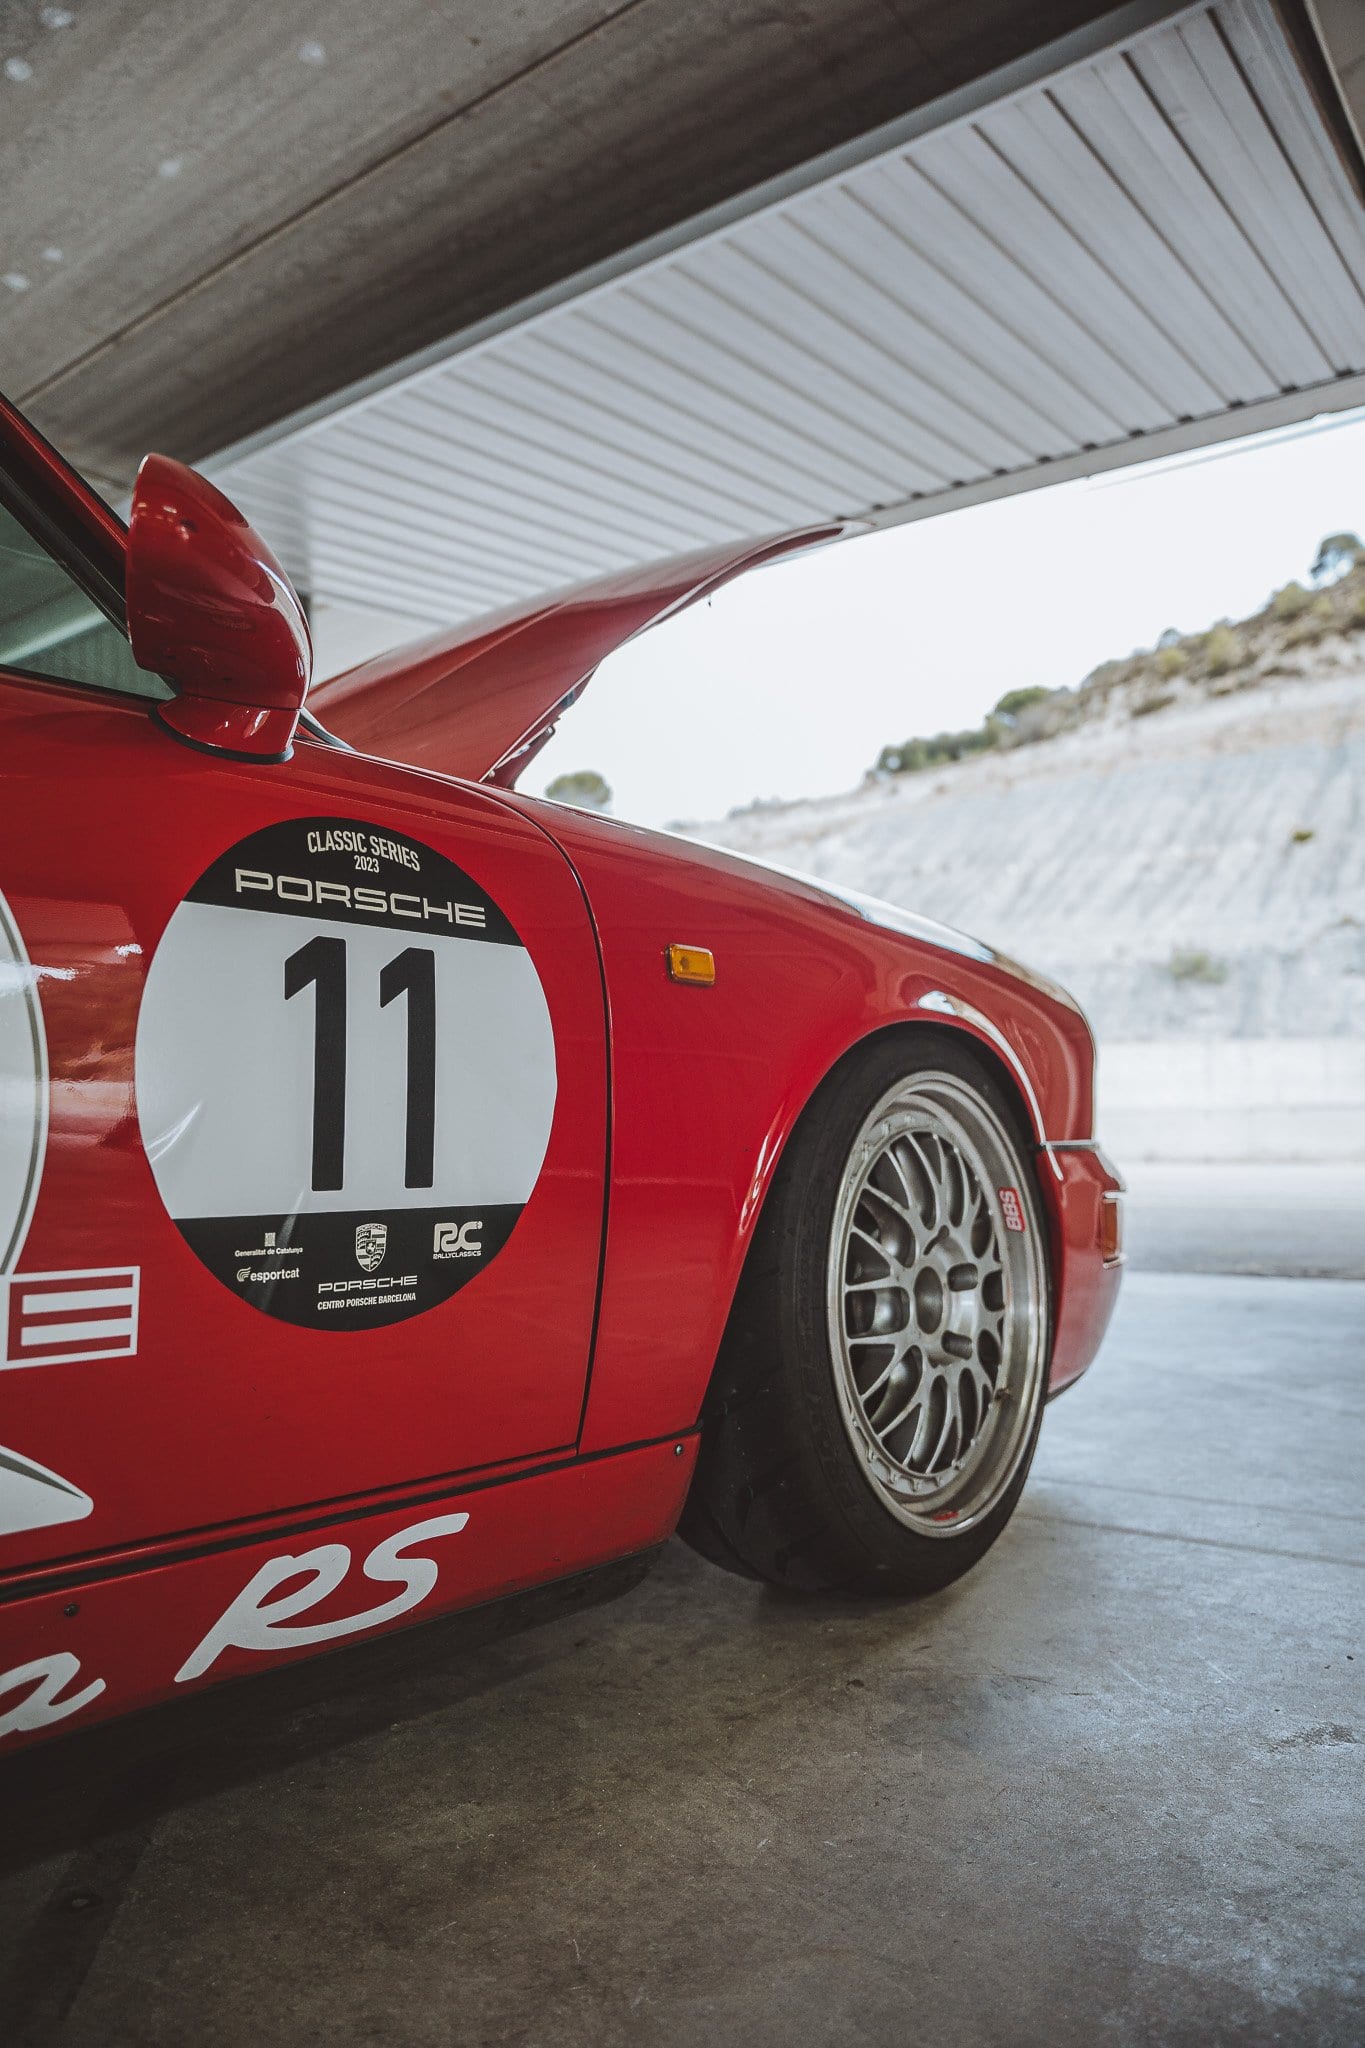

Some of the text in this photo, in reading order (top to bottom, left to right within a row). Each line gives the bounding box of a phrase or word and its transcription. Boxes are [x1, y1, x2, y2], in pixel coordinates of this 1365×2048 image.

[307, 830, 420, 872] CLASSIC SERIES
[354, 855, 380, 873] 2023
[235, 869, 486, 928] PORSCHE
[285, 936, 436, 1191] 11
[1000, 1190, 1022, 1230] BBS
[234, 1249, 266, 1257] Generalitat
[433, 1250, 482, 1260] RALLYCLASSICS
[250, 1267, 300, 1283] esportcat
[318, 1275, 418, 1294] PORSCHE
[317, 1292, 417, 1310] CENTRO PORSCHE BARCELONA
